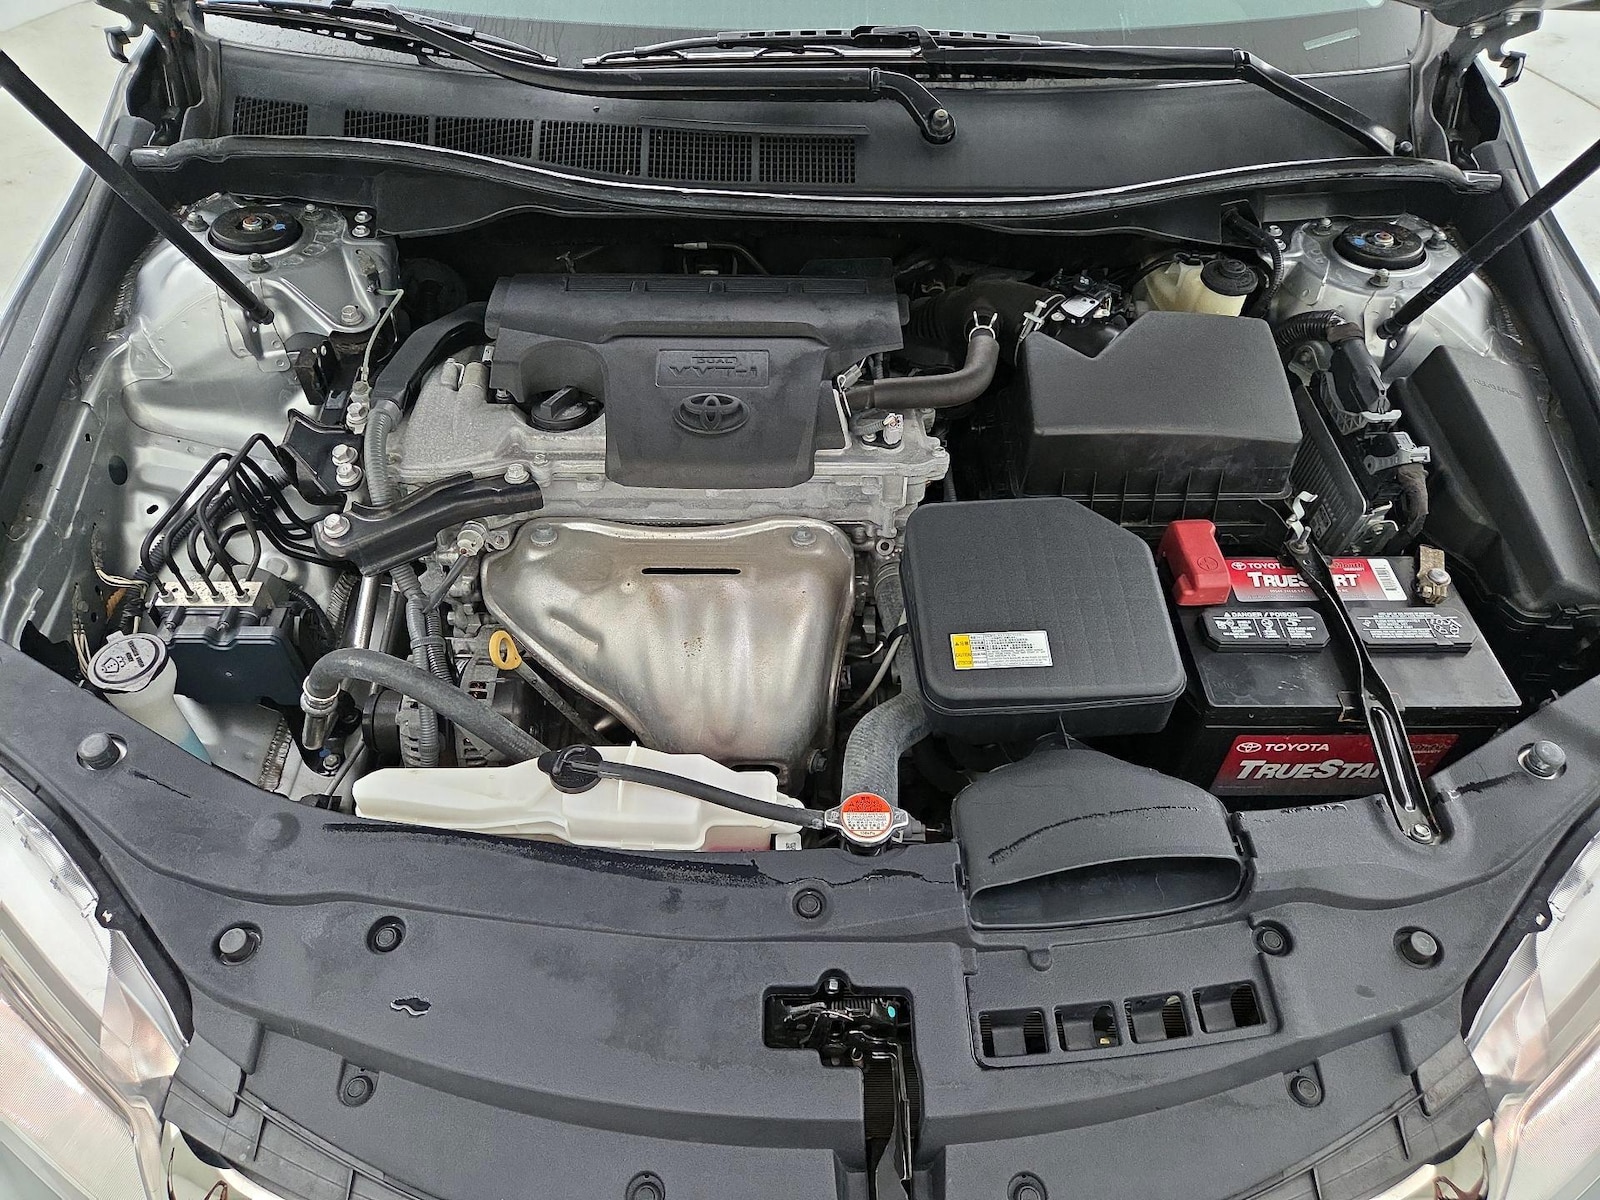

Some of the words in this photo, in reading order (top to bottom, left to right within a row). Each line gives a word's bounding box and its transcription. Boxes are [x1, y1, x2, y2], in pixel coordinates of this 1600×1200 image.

[1247, 562, 1281, 570] TOYOT
[1265, 743, 1329, 752] TOYOTA
[1236, 759, 1380, 780] TRUESTA
